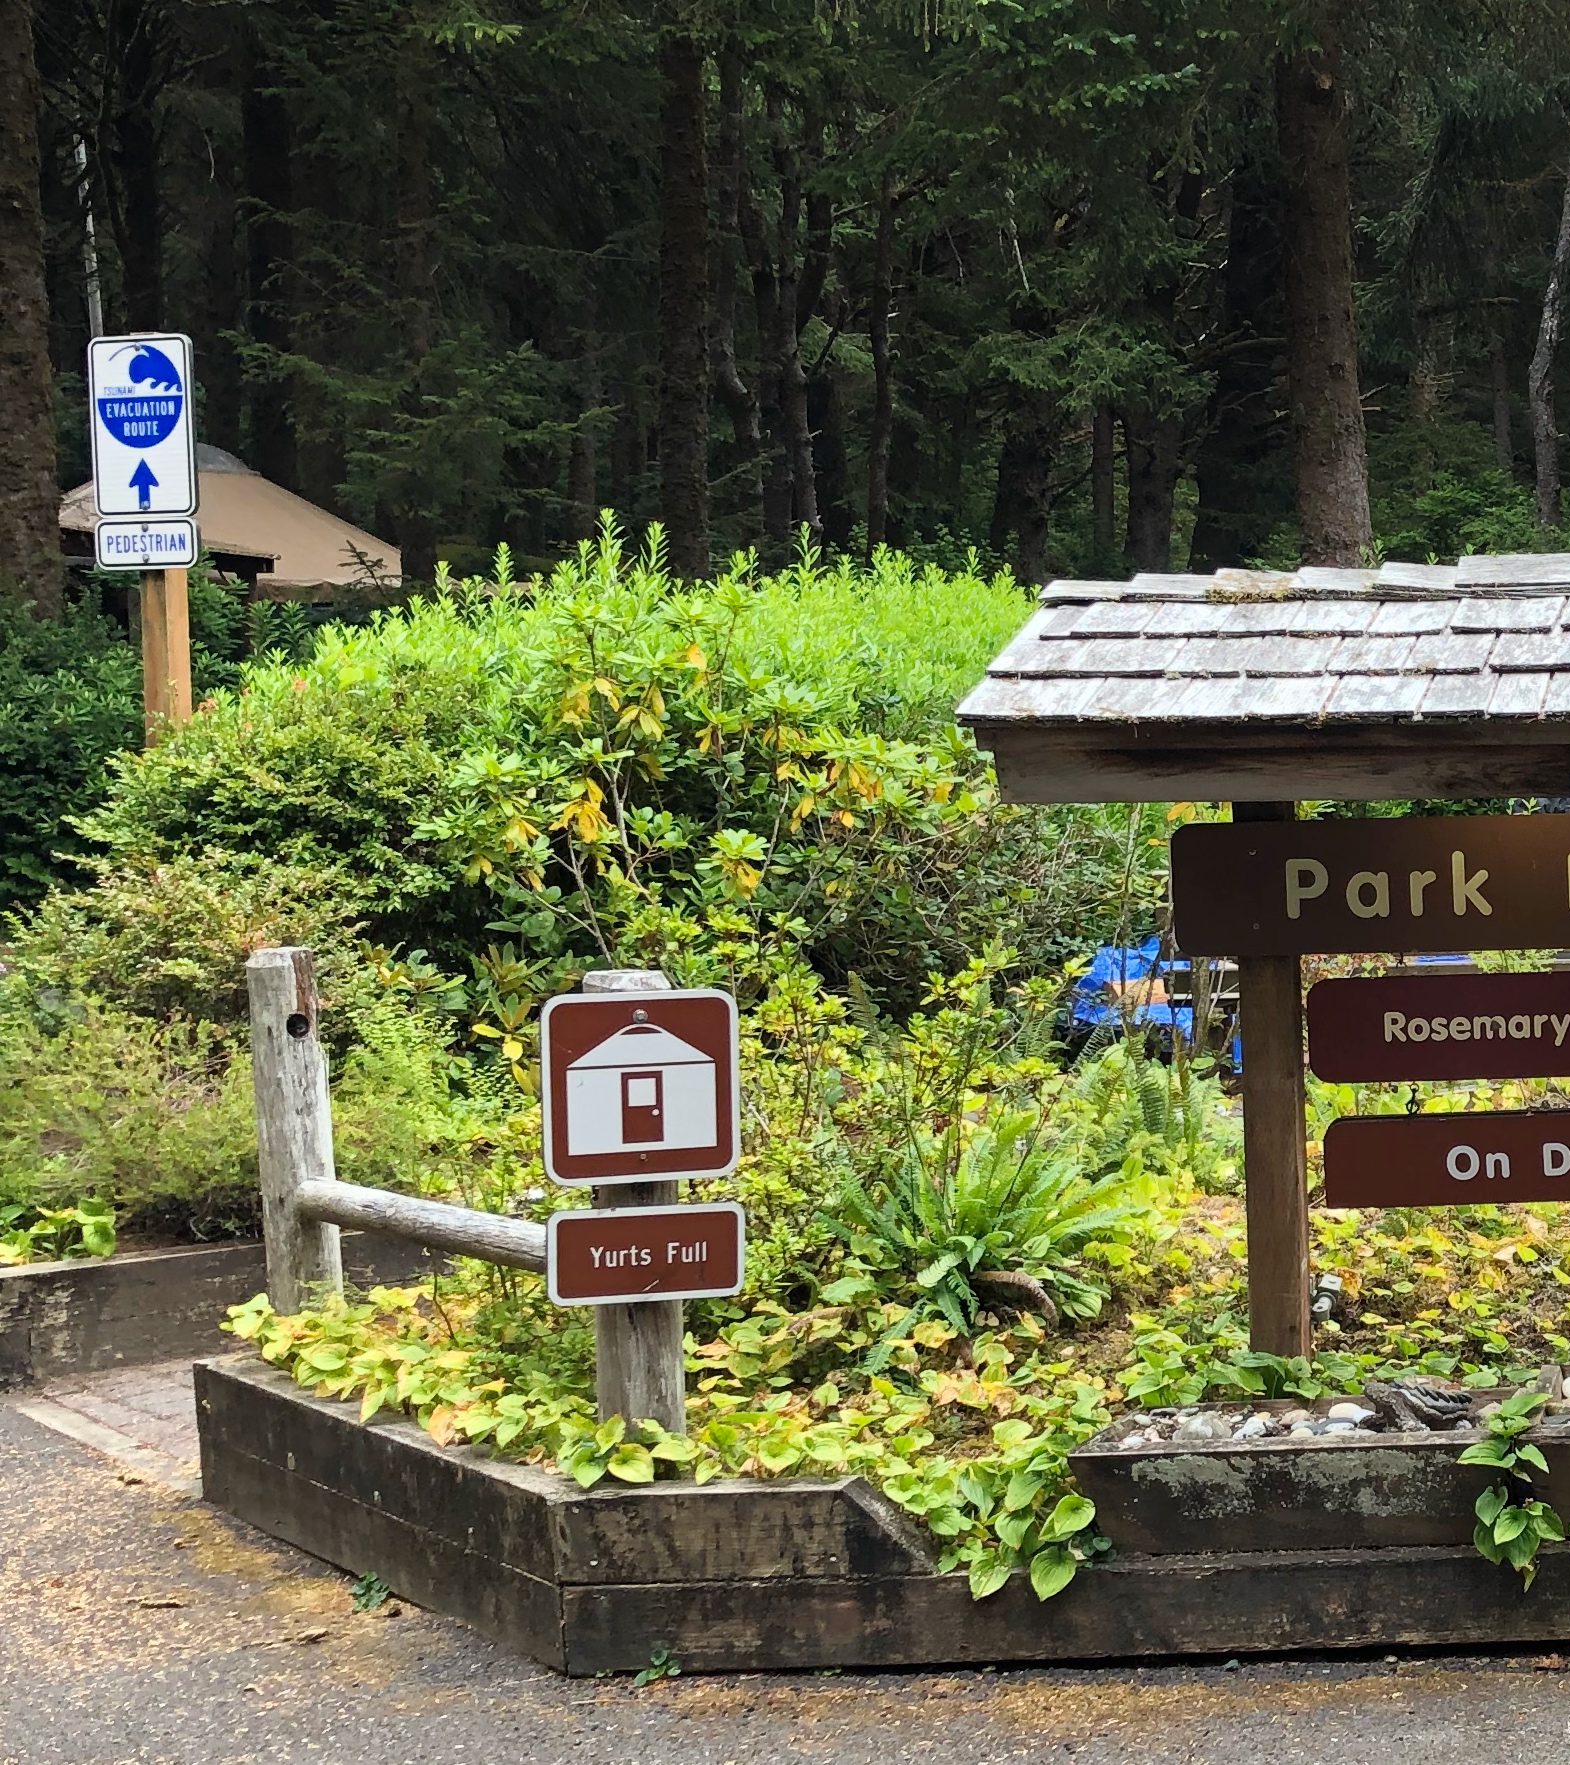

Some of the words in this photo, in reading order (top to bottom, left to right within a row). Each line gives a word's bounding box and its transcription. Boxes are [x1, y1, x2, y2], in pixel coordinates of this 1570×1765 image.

[104, 386, 135, 396] TSUNAMI
[106, 401, 175, 418] EVACUATION
[123, 421, 159, 437] ROUTE
[107, 533, 185, 553] PEDESTRIAN
[1286, 851, 1492, 919] Park
[1384, 1002, 1570, 1047] Rosemary
[1446, 1145, 1510, 1180] On
[590, 1245, 652, 1268] Yurts
[667, 1241, 707, 1264] Full
